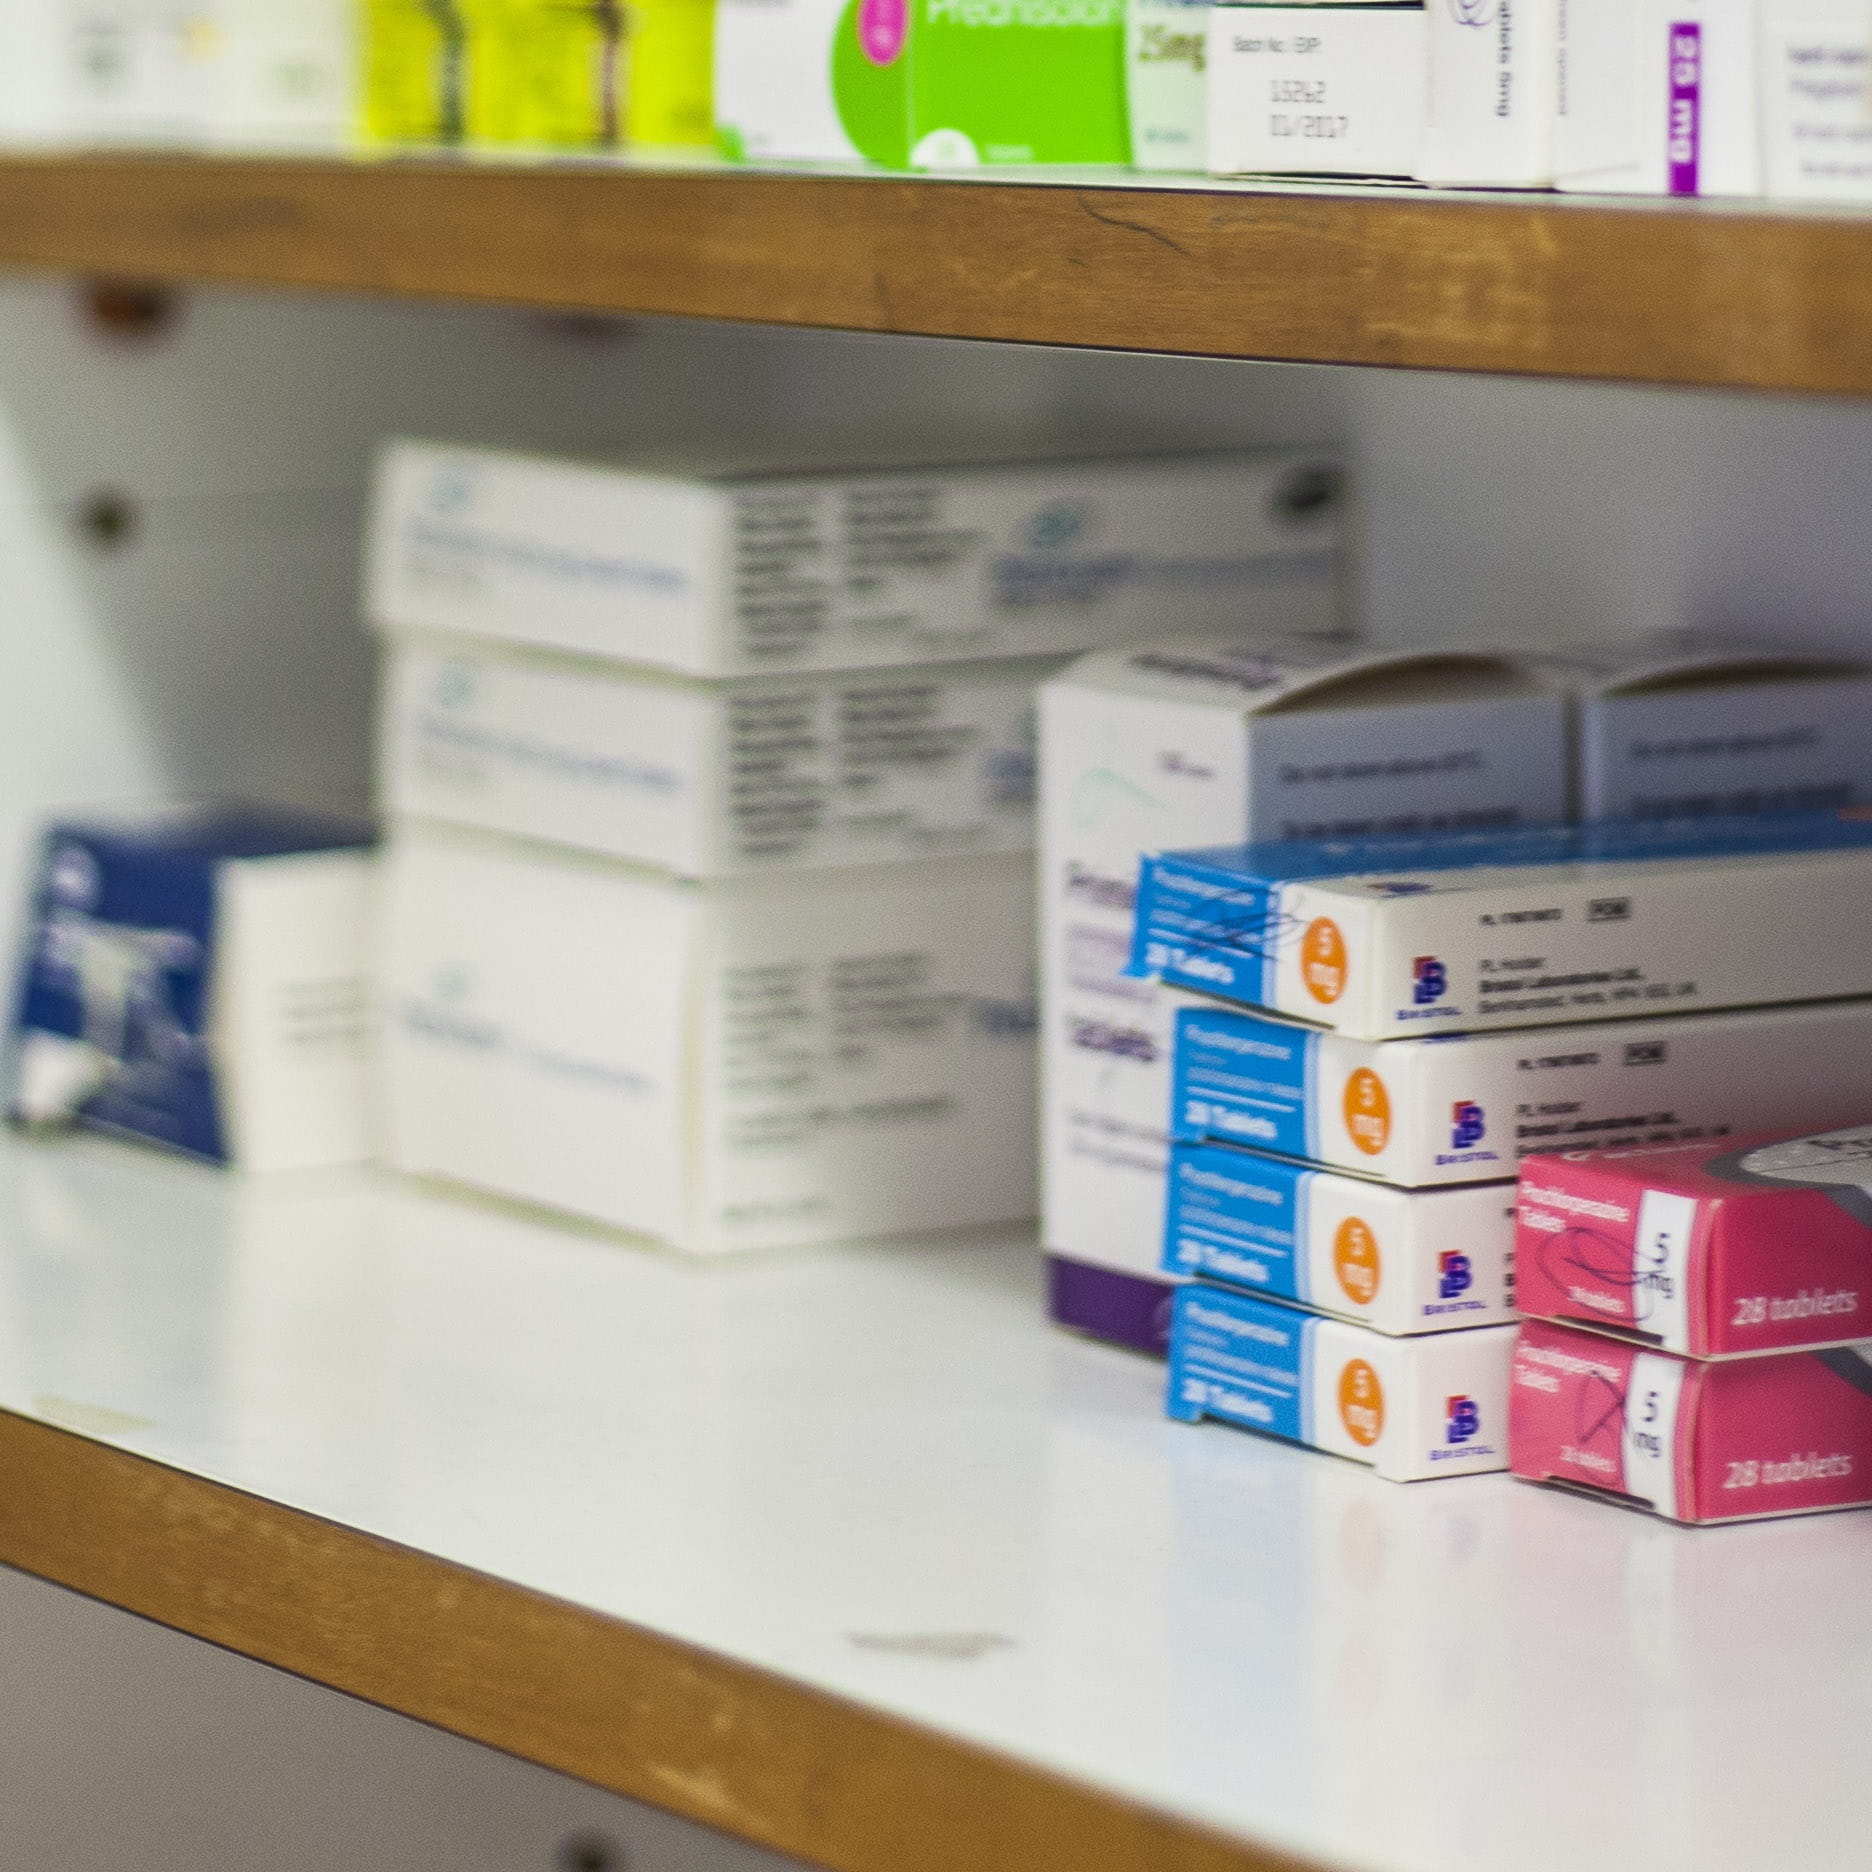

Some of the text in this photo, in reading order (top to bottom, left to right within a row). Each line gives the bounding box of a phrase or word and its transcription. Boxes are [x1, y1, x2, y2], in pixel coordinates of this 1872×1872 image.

[1674, 34, 1698, 87] 25
[1495, 71, 1513, 118] 5mg
[1671, 99, 1694, 165] mg
[1318, 927, 1333, 957] 5
[1309, 962, 1340, 999] mg
[1358, 1077, 1376, 1108] 5
[1350, 1113, 1386, 1149] mg
[1349, 1226, 1366, 1257] 5
[1653, 1231, 1671, 1265] 5
[1341, 1261, 1376, 1298] mg
[1644, 1271, 1674, 1301] mg
[1731, 1288, 1860, 1327] 28 tablets
[1354, 1368, 1370, 1398] 5
[1345, 1403, 1380, 1441] mg
[1642, 1390, 1659, 1424] 5
[1633, 1431, 1662, 1460] mg
[1723, 1450, 1853, 1490] 28 tablets
